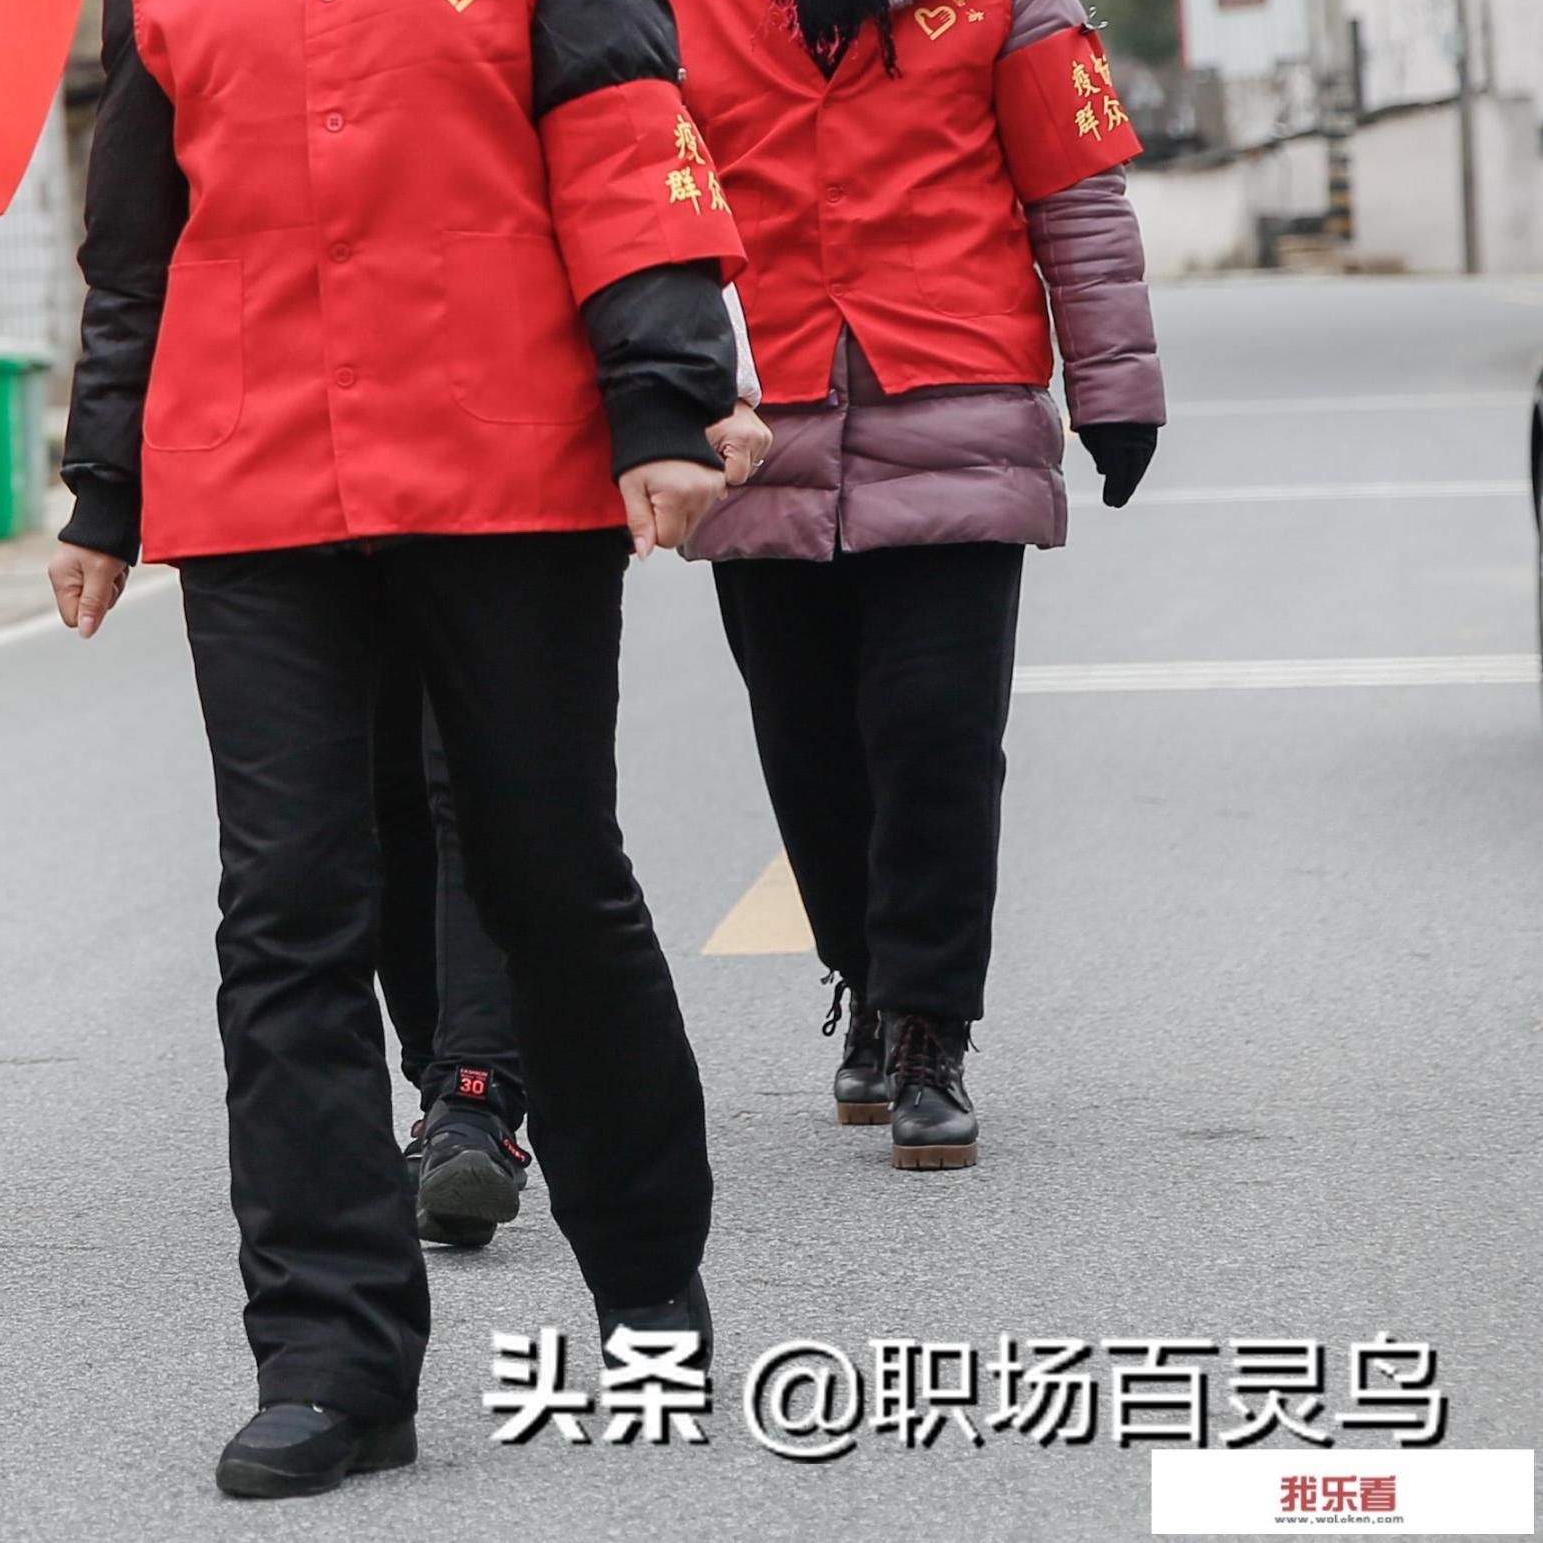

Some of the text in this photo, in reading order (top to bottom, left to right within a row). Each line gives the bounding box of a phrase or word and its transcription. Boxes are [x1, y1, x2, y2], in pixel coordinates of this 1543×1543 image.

[674, 113, 706, 166] 疫
[1074, 94, 1130, 142] 群众
[665, 165, 733, 216] 群众
[459, 1077, 485, 1095] 30
